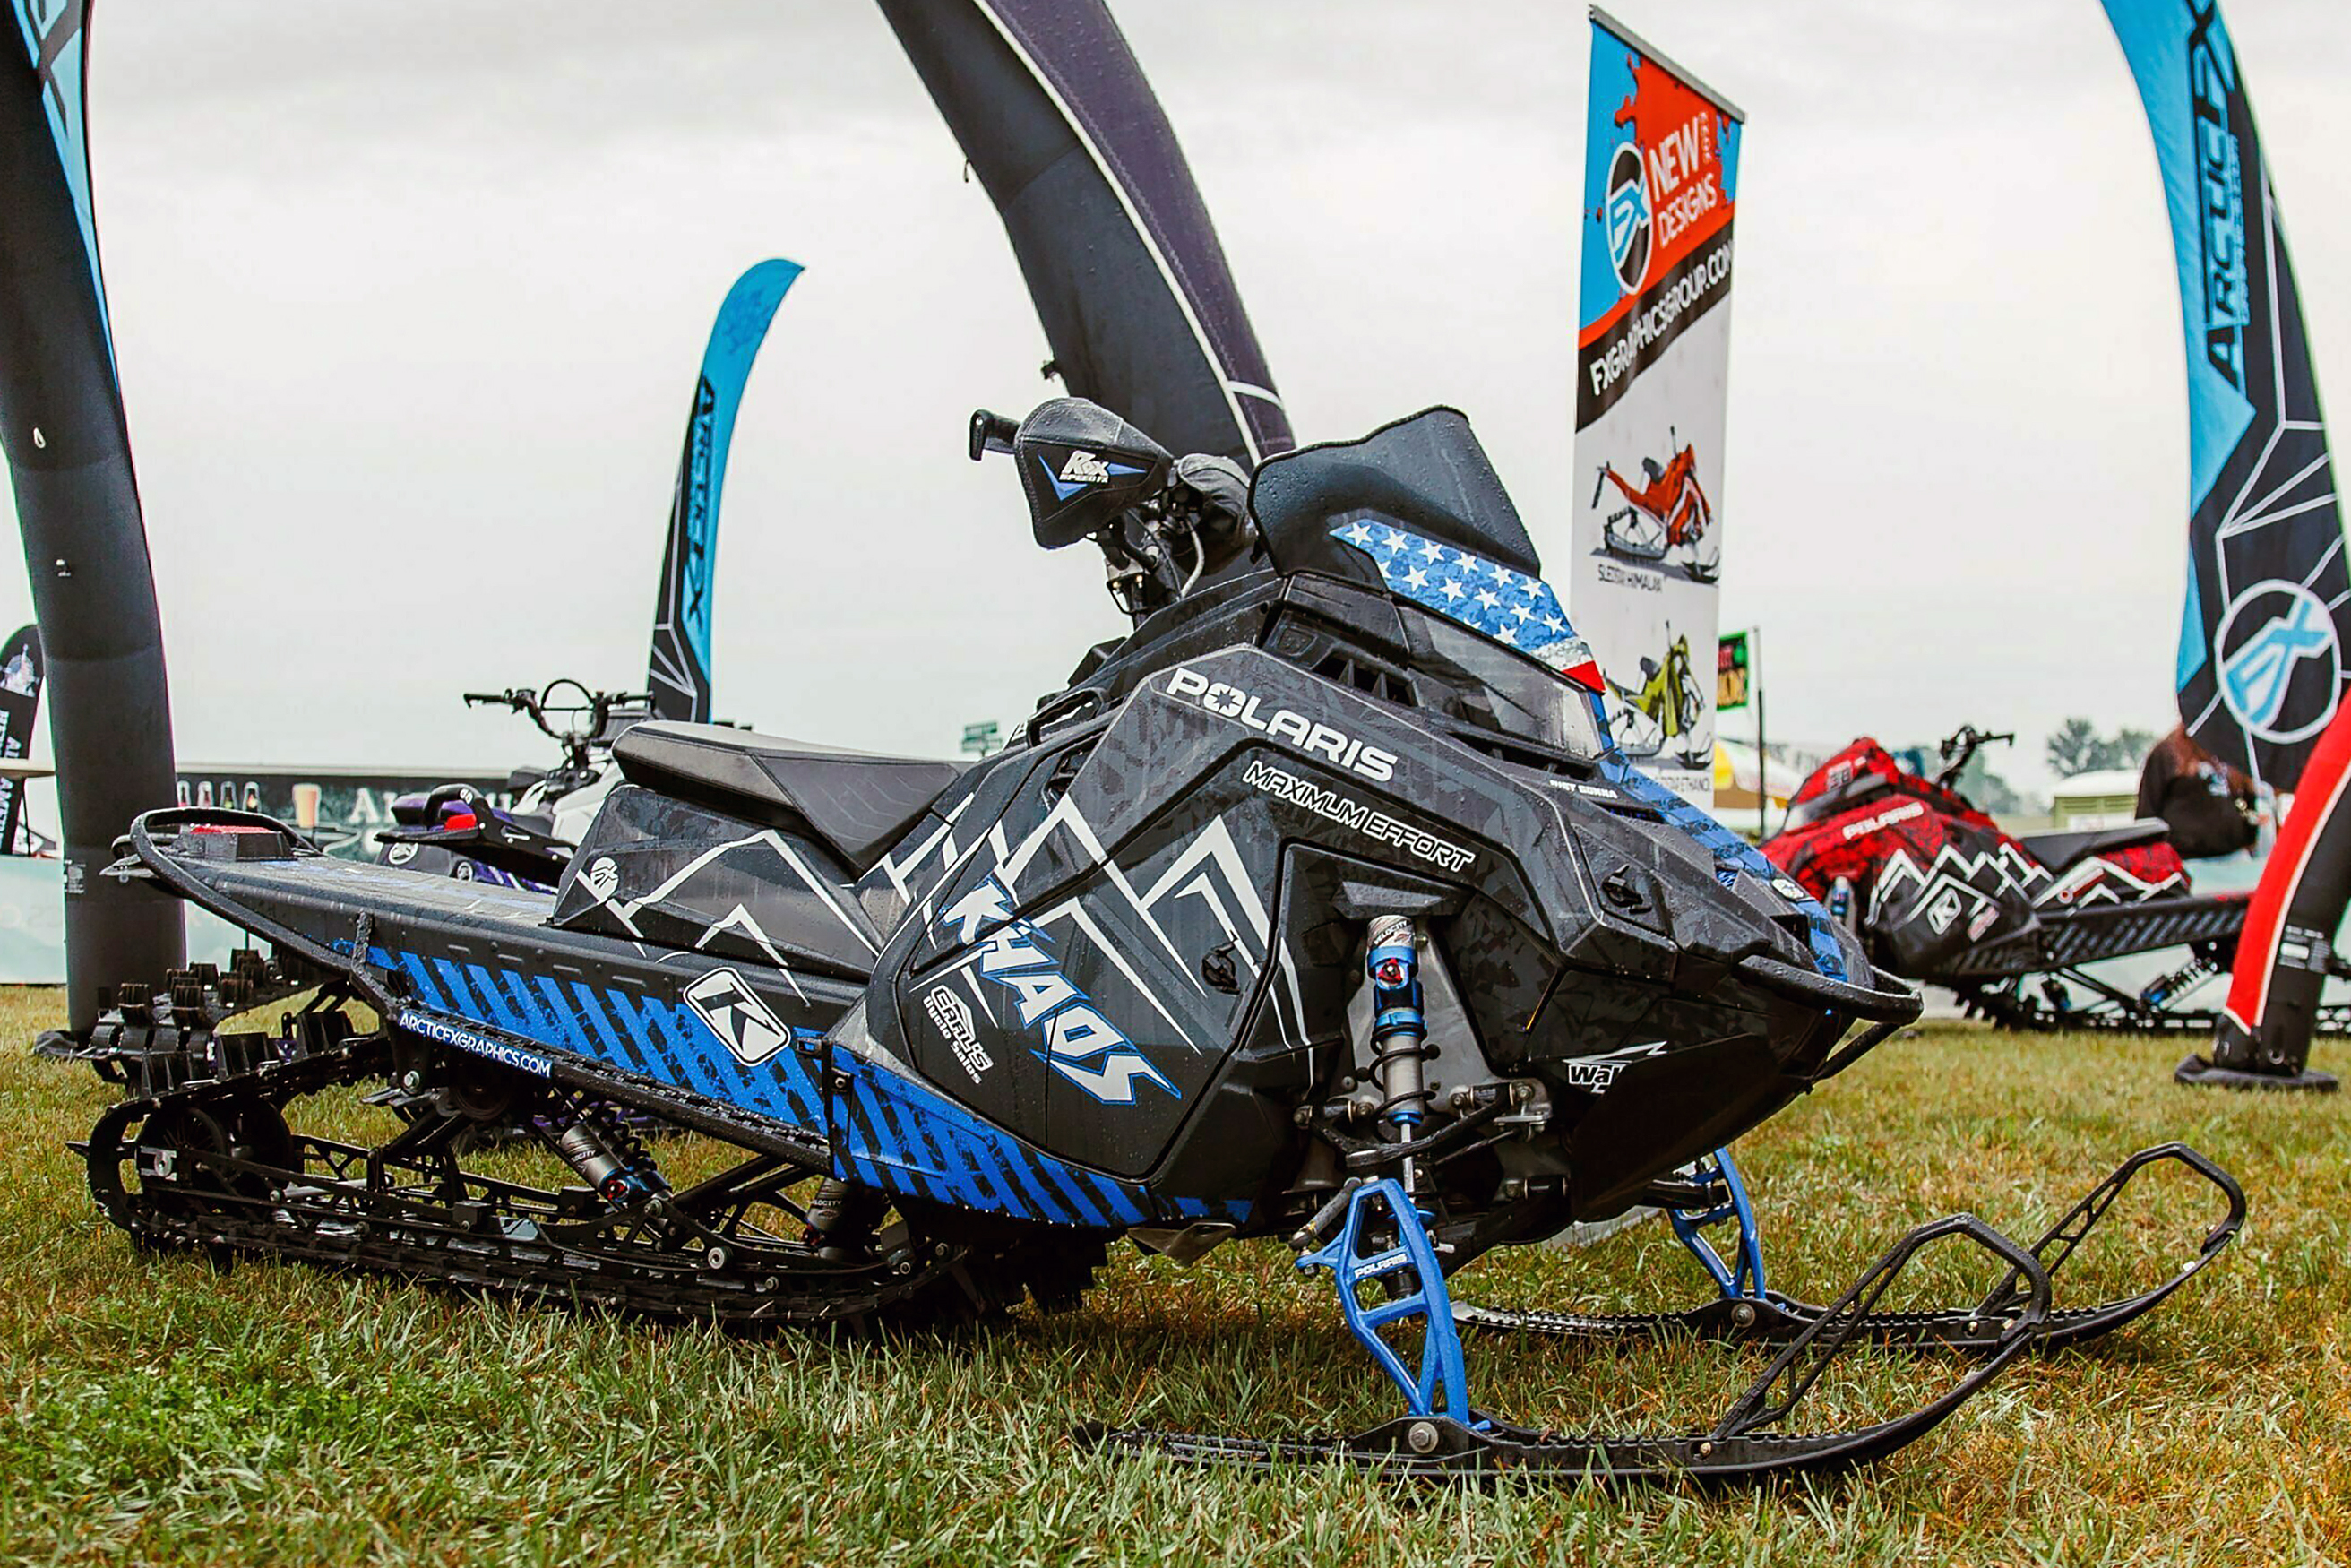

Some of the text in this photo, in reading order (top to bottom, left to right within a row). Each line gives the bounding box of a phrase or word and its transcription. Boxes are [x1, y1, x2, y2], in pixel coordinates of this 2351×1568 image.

[1649, 116, 1700, 202] NEW
[1658, 172, 1718, 249] DESIGNS
[1166, 668, 1398, 782] POLARIS
[1243, 761, 1476, 873] MAXIMUM EFFORT
[939, 873, 1183, 1106] KHAOS
[400, 1012, 552, 1078] ARCTICFXGRAPHICS.COM
[1354, 1253, 1408, 1280] POLARIS
